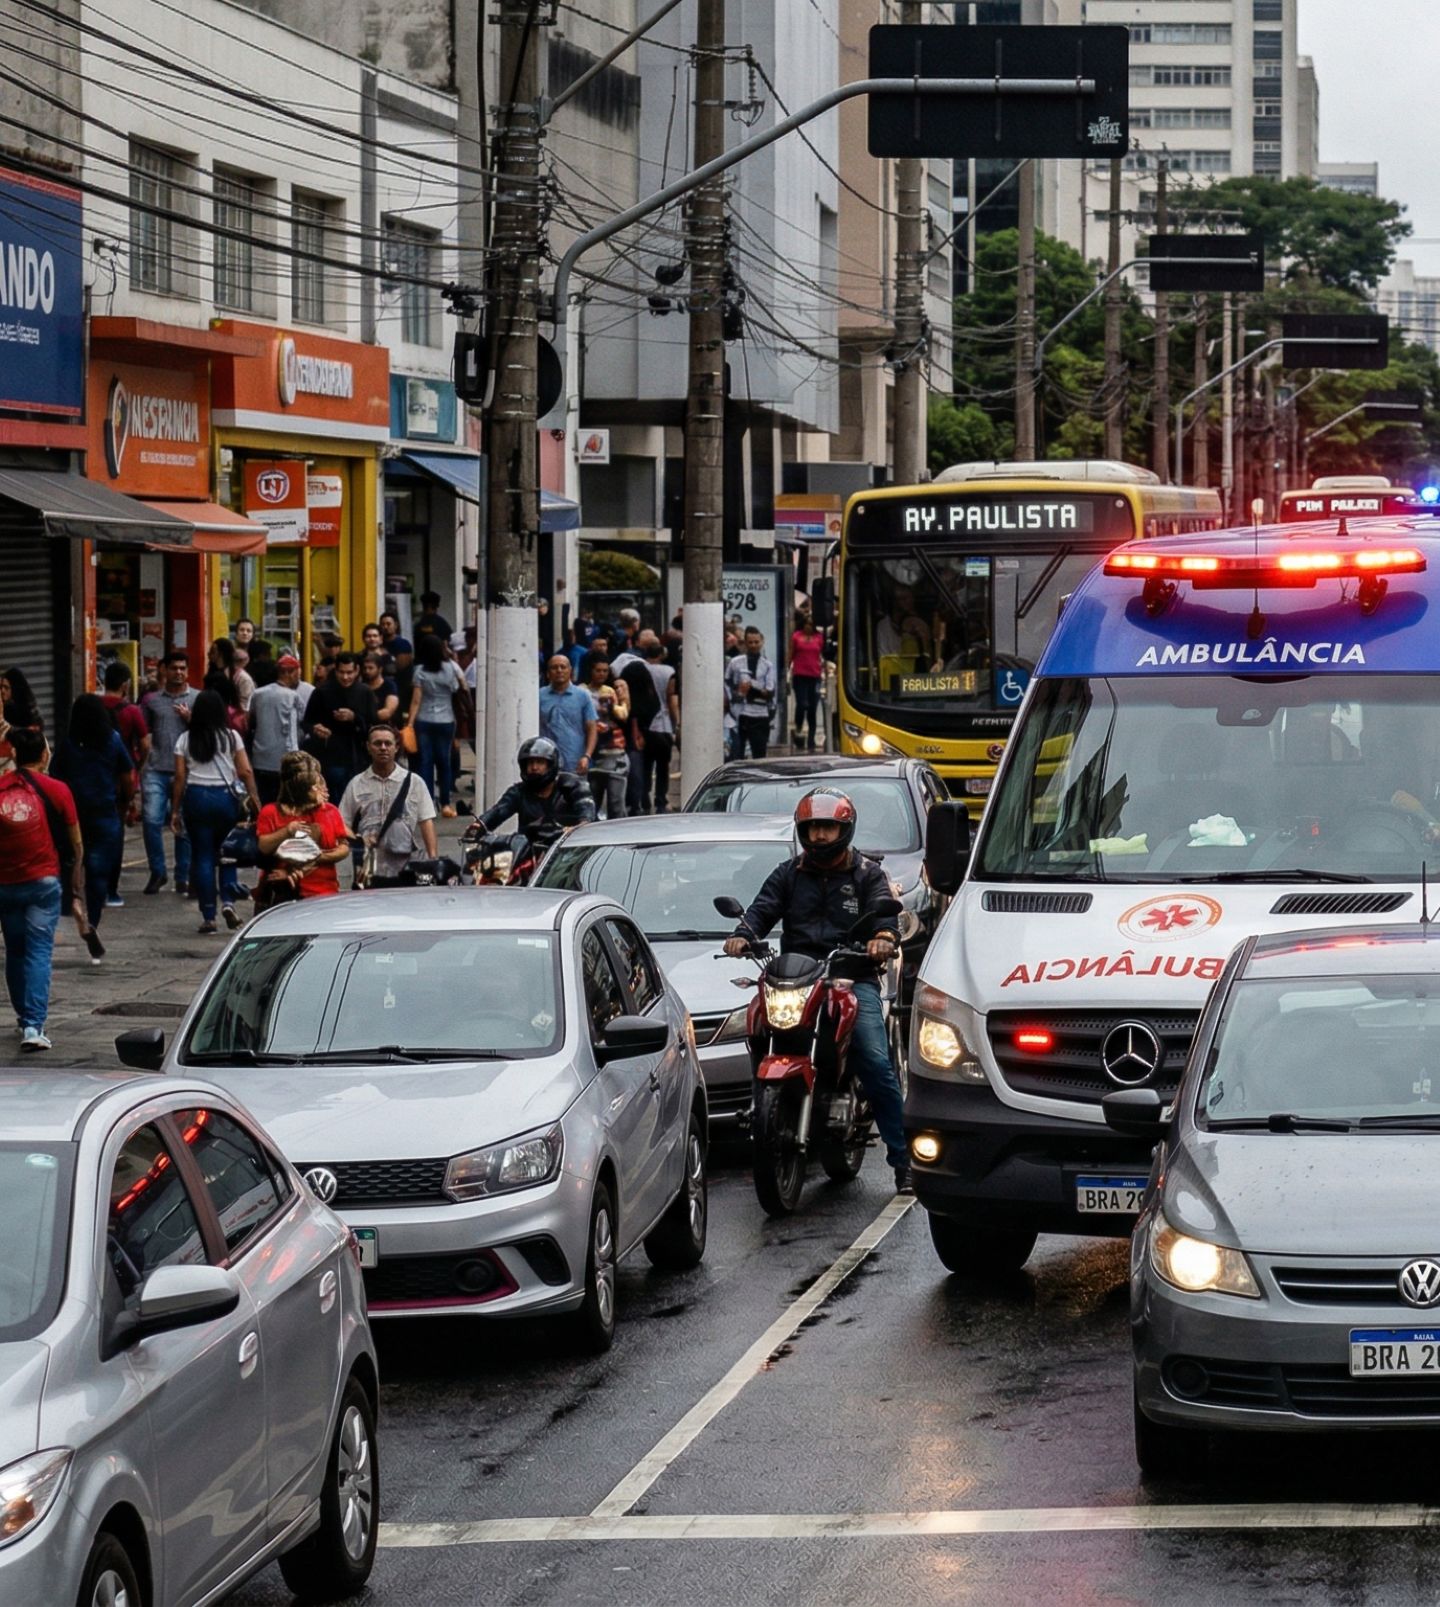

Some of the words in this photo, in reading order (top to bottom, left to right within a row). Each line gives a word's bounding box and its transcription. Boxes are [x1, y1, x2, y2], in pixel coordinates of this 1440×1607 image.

[949, 504, 1077, 531] PAULISTA
[1136, 637, 1366, 667] AMBULÂNCIA
[1085, 1190, 1120, 1210] BRA
[1362, 1345, 1411, 1371] BRA
